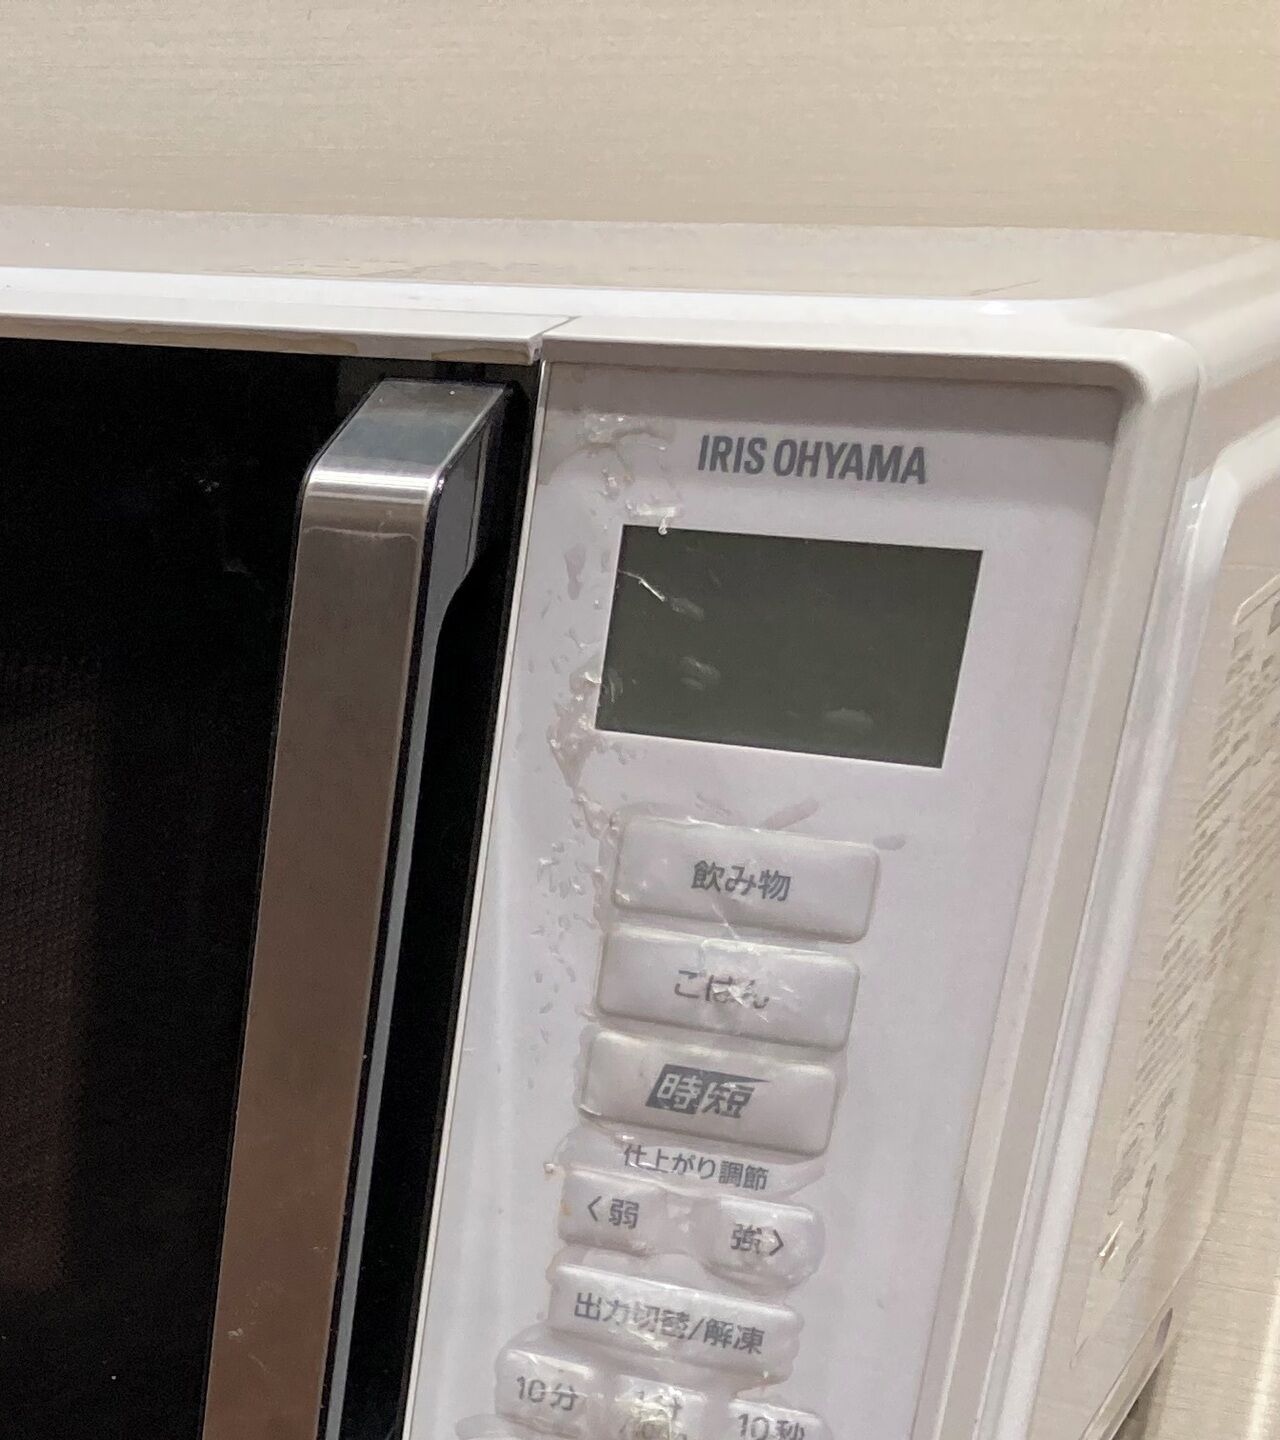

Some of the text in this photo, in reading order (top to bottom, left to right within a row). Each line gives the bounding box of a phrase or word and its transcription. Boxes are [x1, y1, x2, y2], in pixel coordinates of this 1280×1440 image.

[698, 434, 928, 485] IRIS OHYAMA
[690, 859, 792, 902] 飲み物
[653, 1068, 758, 1118] 時短
[623, 1144, 770, 1192] 仕上がり調節
[516, 1375, 579, 1412] 10分
